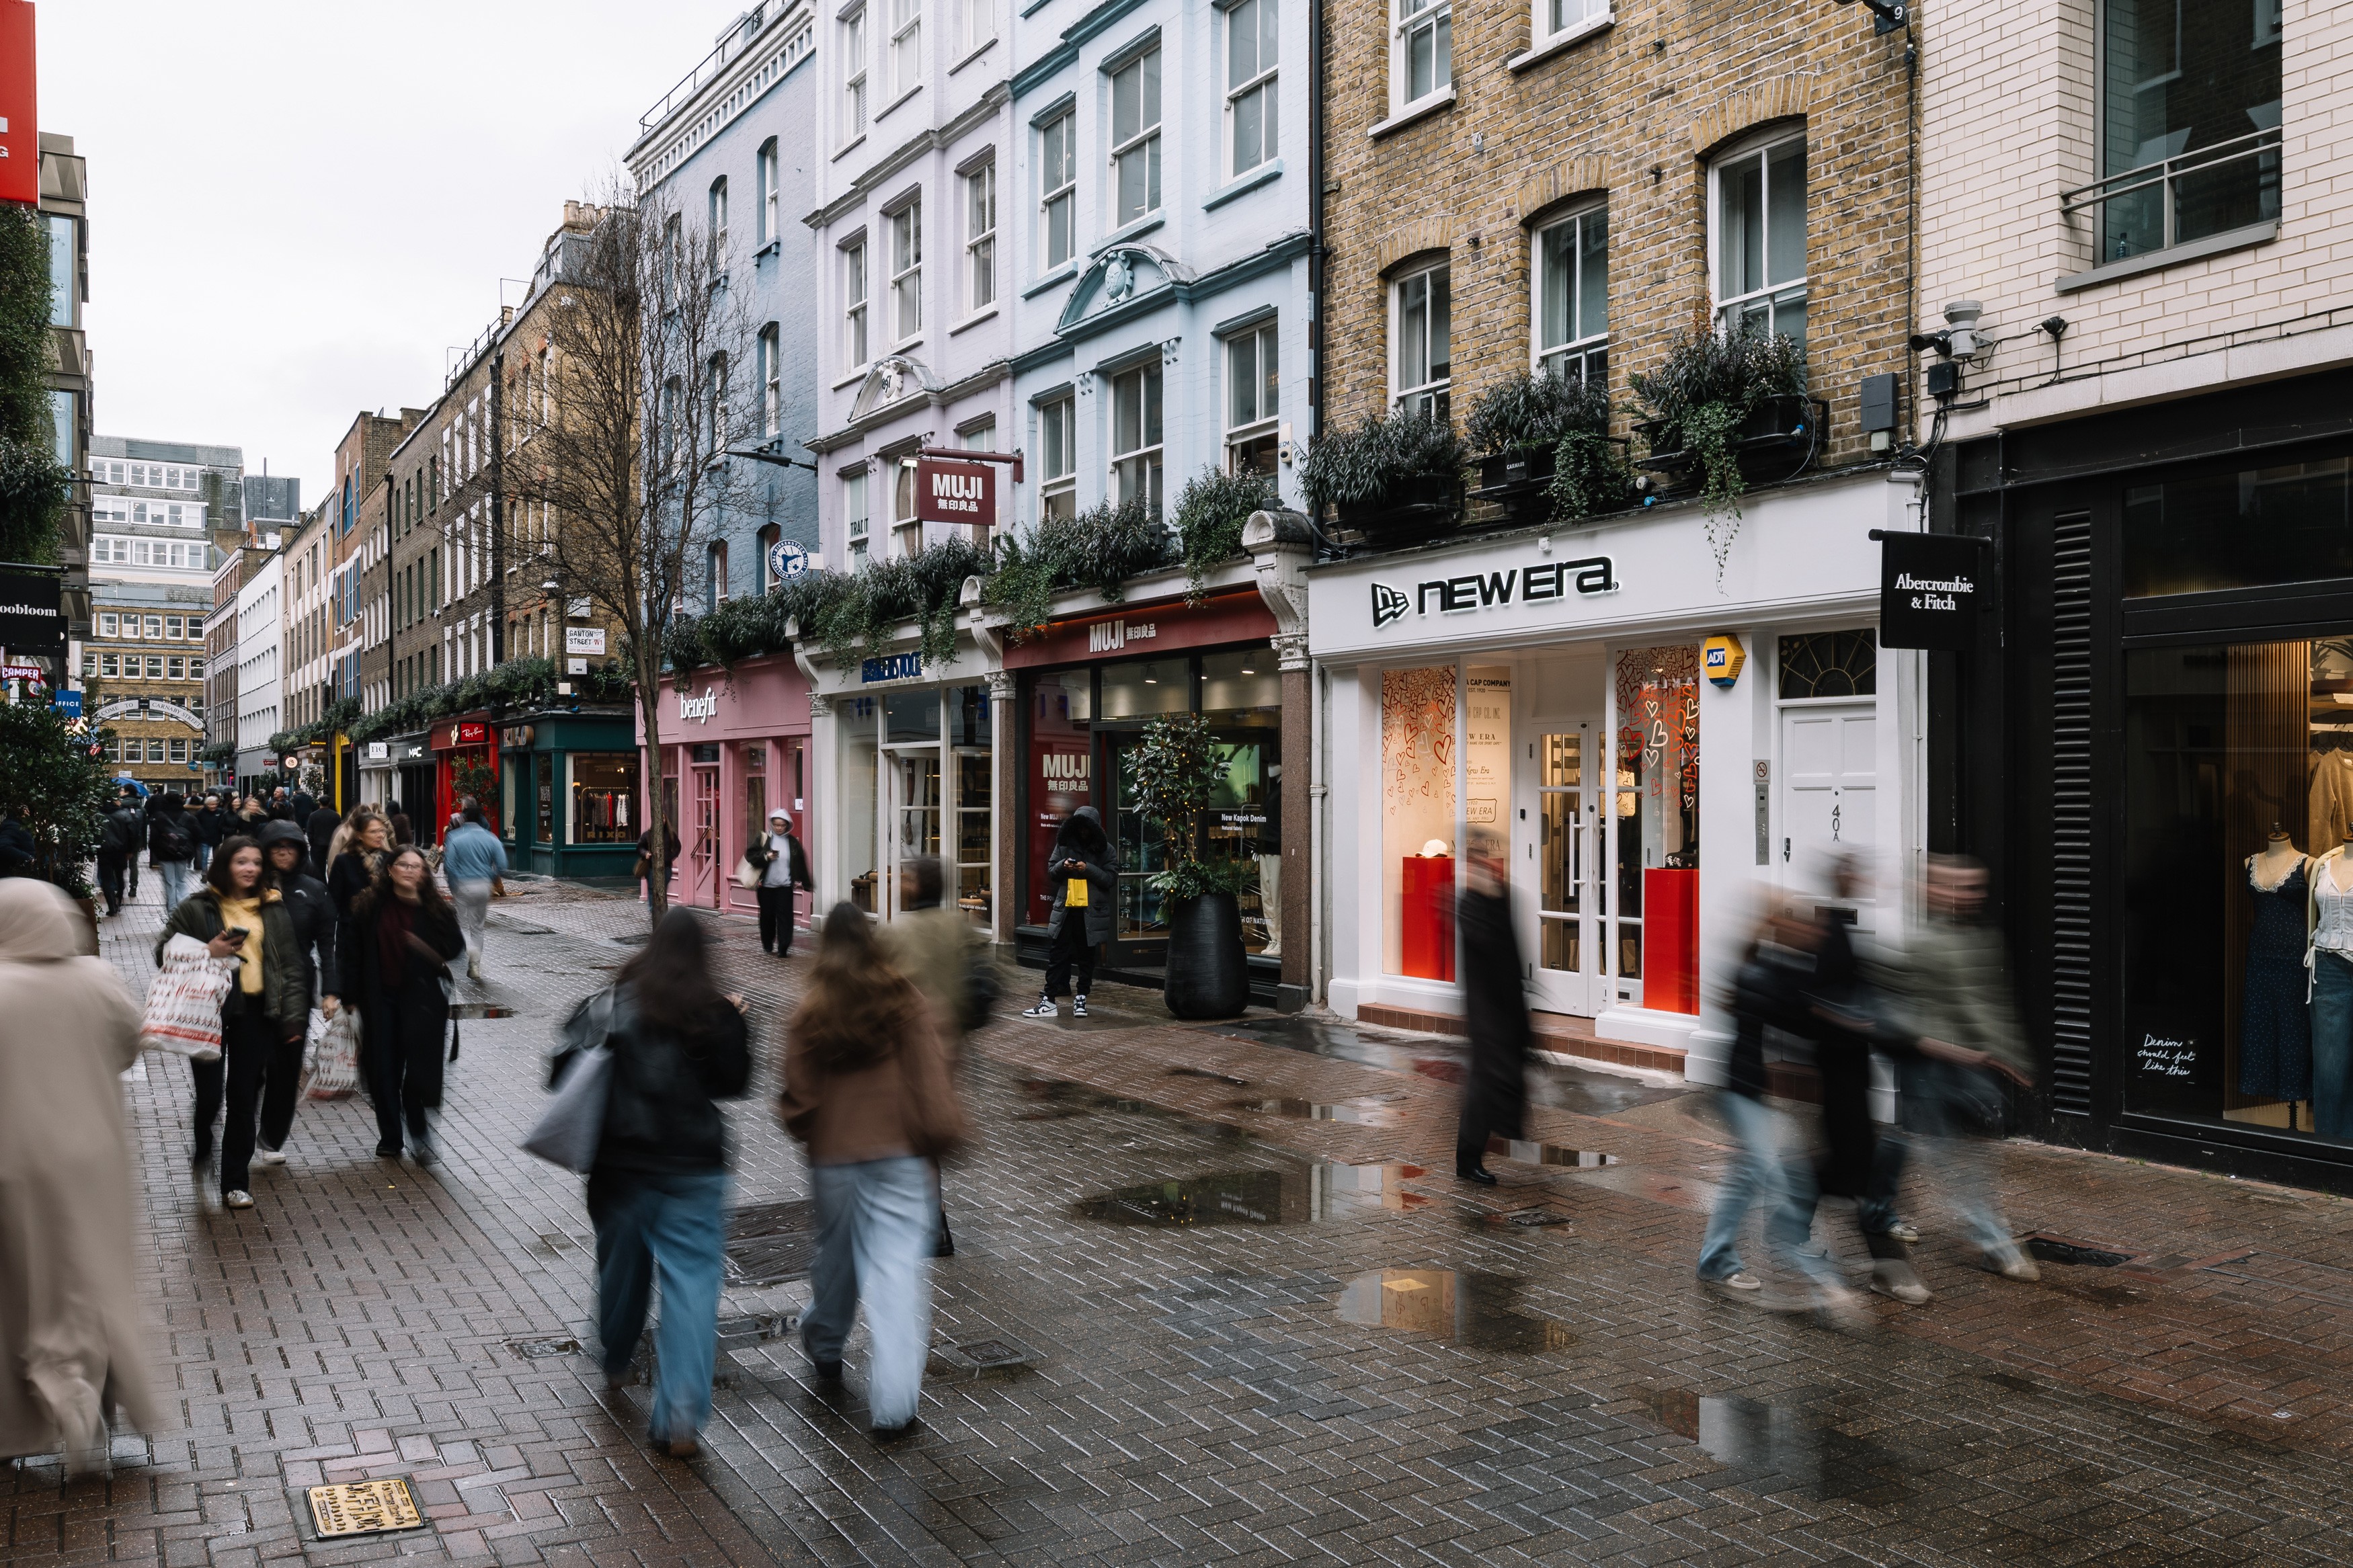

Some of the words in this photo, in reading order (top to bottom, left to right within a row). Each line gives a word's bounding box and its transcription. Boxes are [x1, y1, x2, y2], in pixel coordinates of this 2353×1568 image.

[932, 473, 983, 499] MUJI
[938, 499, 978, 512] 無印良品
[774, 541, 805, 554] BIRKENSTOCK
[772, 556, 789, 578] TRADITION
[790, 570, 805, 579] SINCE
[1895, 573, 1974, 593] Abercrombie
[1911, 597, 1923, 609] &
[1924, 593, 1956, 610] Fitch
[1089, 620, 1125, 653] MUJI
[1126, 623, 1156, 641] 無印良品
[1708, 651, 1725, 664] ADT
[3, 667, 39, 680] CAMPER
[680, 687, 717, 724] benefit
[152, 702, 182, 714] CARNABY
[182, 711, 202, 728] STREET
[1473, 707, 1482, 718] CAP
[462, 727, 483, 738] Ray-Ban
[409, 747, 422, 758] MAC
[1047, 780, 1088, 791] 無印良品
[1466, 807, 1477, 815] EW
[1479, 807, 1492, 815] ERA
[1222, 813, 1232, 821] New
[1233, 814, 1250, 823] Kapok
[1250, 815, 1267, 823] Denim
[587, 831, 626, 839] RIXO
[2143, 1033, 2183, 1047] Denim
[2137, 1049, 2170, 1059] should
[2171, 1051, 2195, 1065] feel
[2142, 1059, 2165, 1071] like
[2165, 1065, 2190, 1076] this
